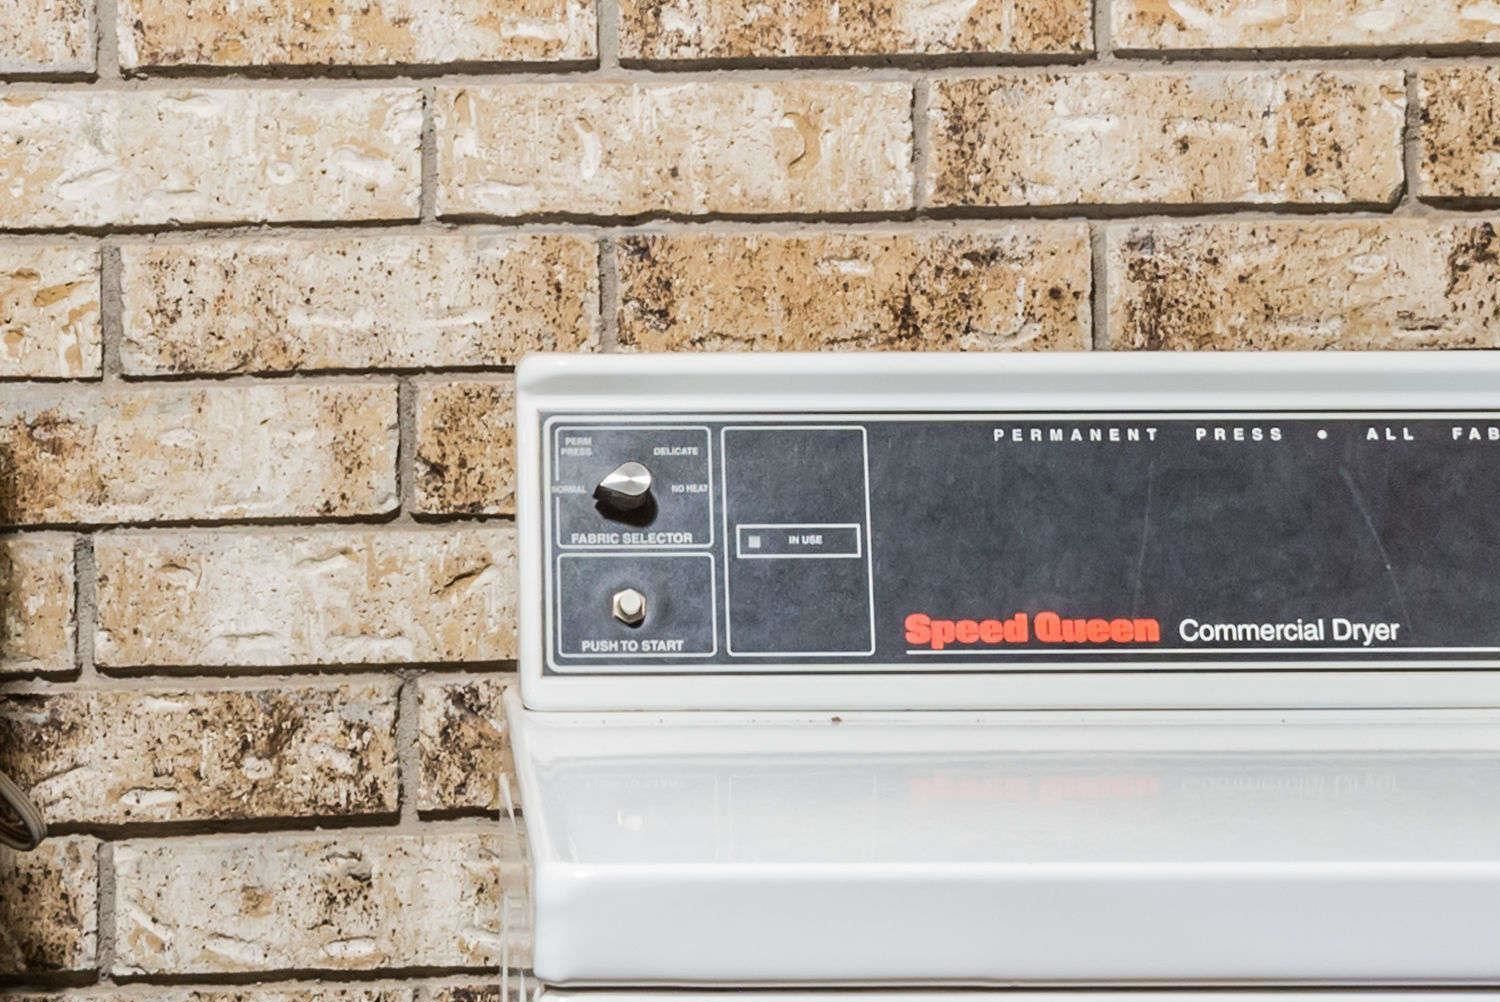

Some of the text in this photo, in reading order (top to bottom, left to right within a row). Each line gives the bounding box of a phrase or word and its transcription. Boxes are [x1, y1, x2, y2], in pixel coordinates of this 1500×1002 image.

[992, 426, 1158, 442] PERMANENT
[1195, 426, 1284, 442] PRESS
[1366, 425, 1415, 441] ALL
[653, 447, 698, 456] DELICATE
[571, 532, 693, 544] FABRIC SELECTOR
[789, 535, 823, 545] IN USE
[904, 611, 1400, 649] Speed Queen Commercial Dryer
[581, 640, 684, 652] PUSH TO START
